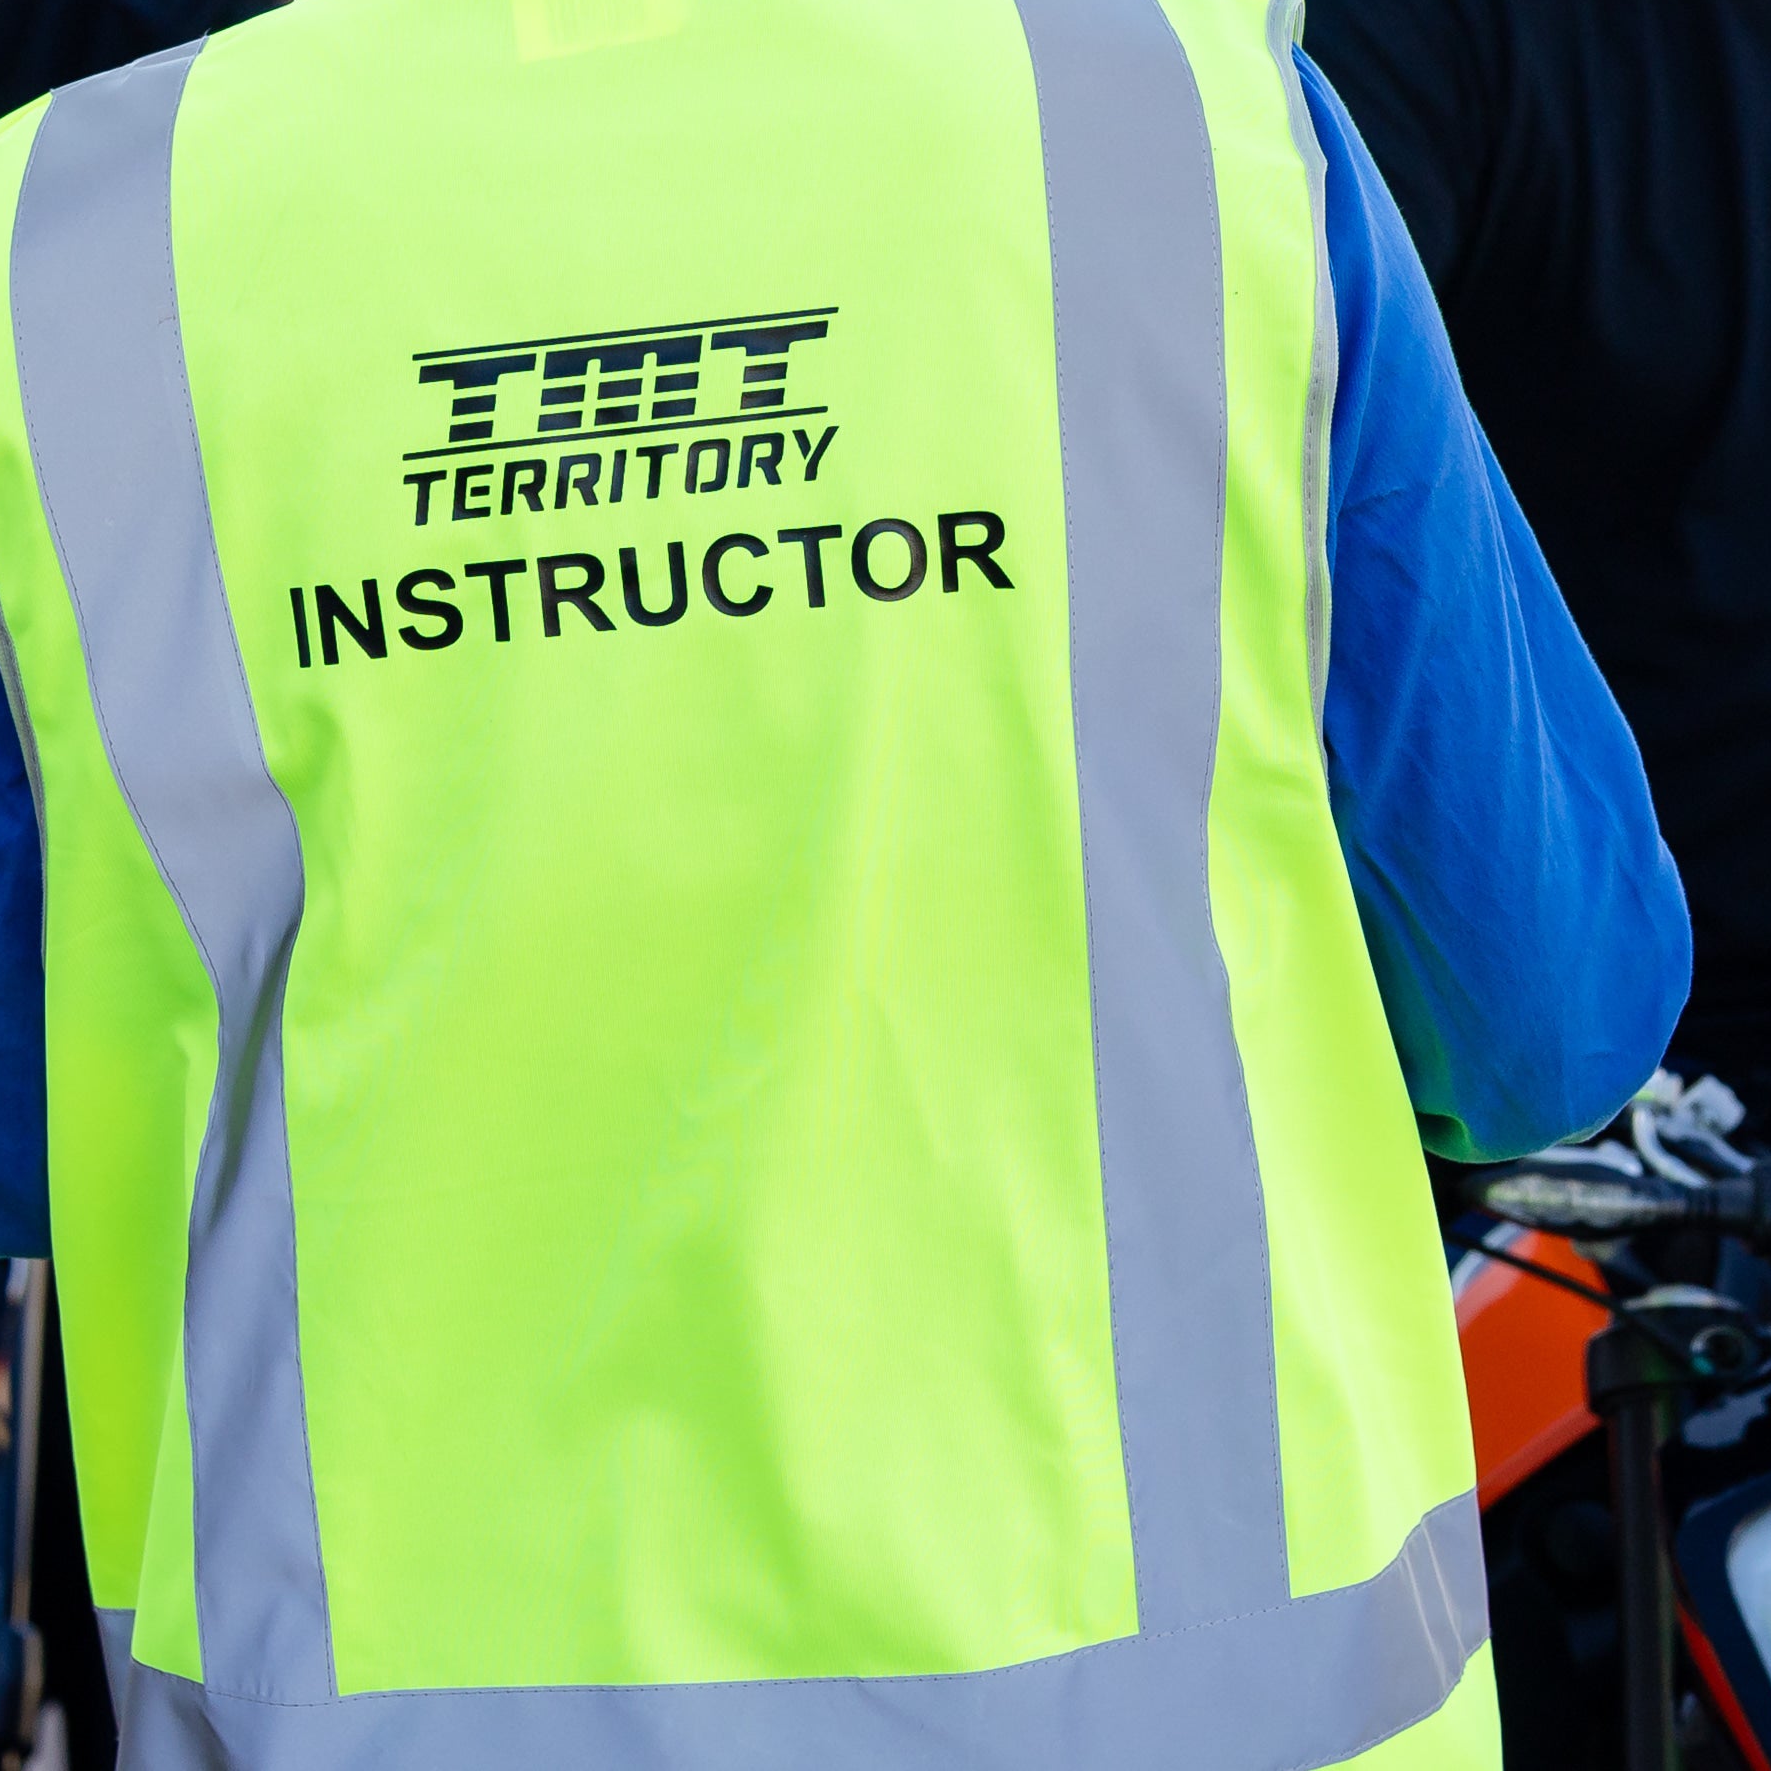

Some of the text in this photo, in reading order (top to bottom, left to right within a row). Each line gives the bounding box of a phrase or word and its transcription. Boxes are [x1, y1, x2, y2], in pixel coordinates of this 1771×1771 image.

[418, 320, 829, 443] TMT
[402, 425, 839, 527] TERRITORY
[289, 510, 1015, 669] INSTRUCTOR
